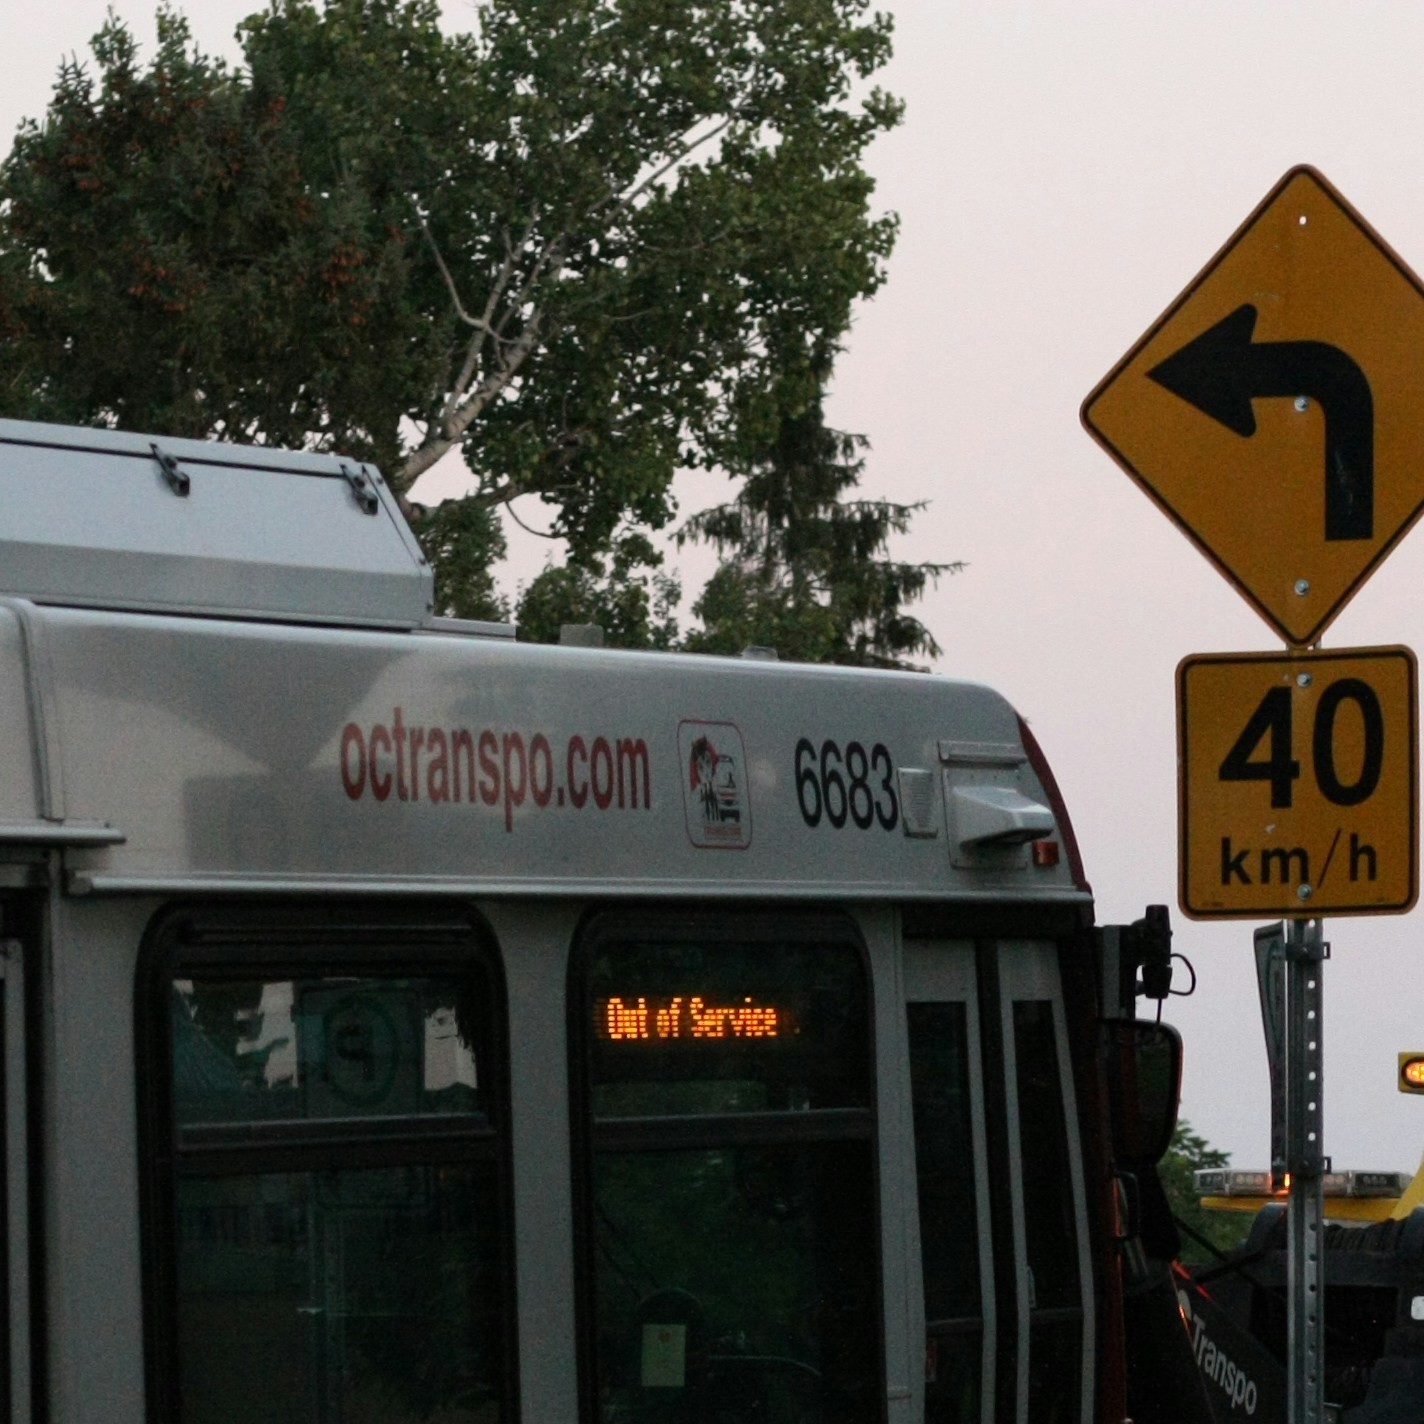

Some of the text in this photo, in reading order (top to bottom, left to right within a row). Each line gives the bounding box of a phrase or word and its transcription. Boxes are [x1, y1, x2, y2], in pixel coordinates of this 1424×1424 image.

[340, 706, 651, 832] octranspo.com
[794, 737, 900, 831] 6683
[1219, 678, 1384, 808] 40
[1220, 828, 1377, 889] km/h
[607, 996, 777, 1040] Out of Service
[1192, 1313, 1258, 1416] Transpo
